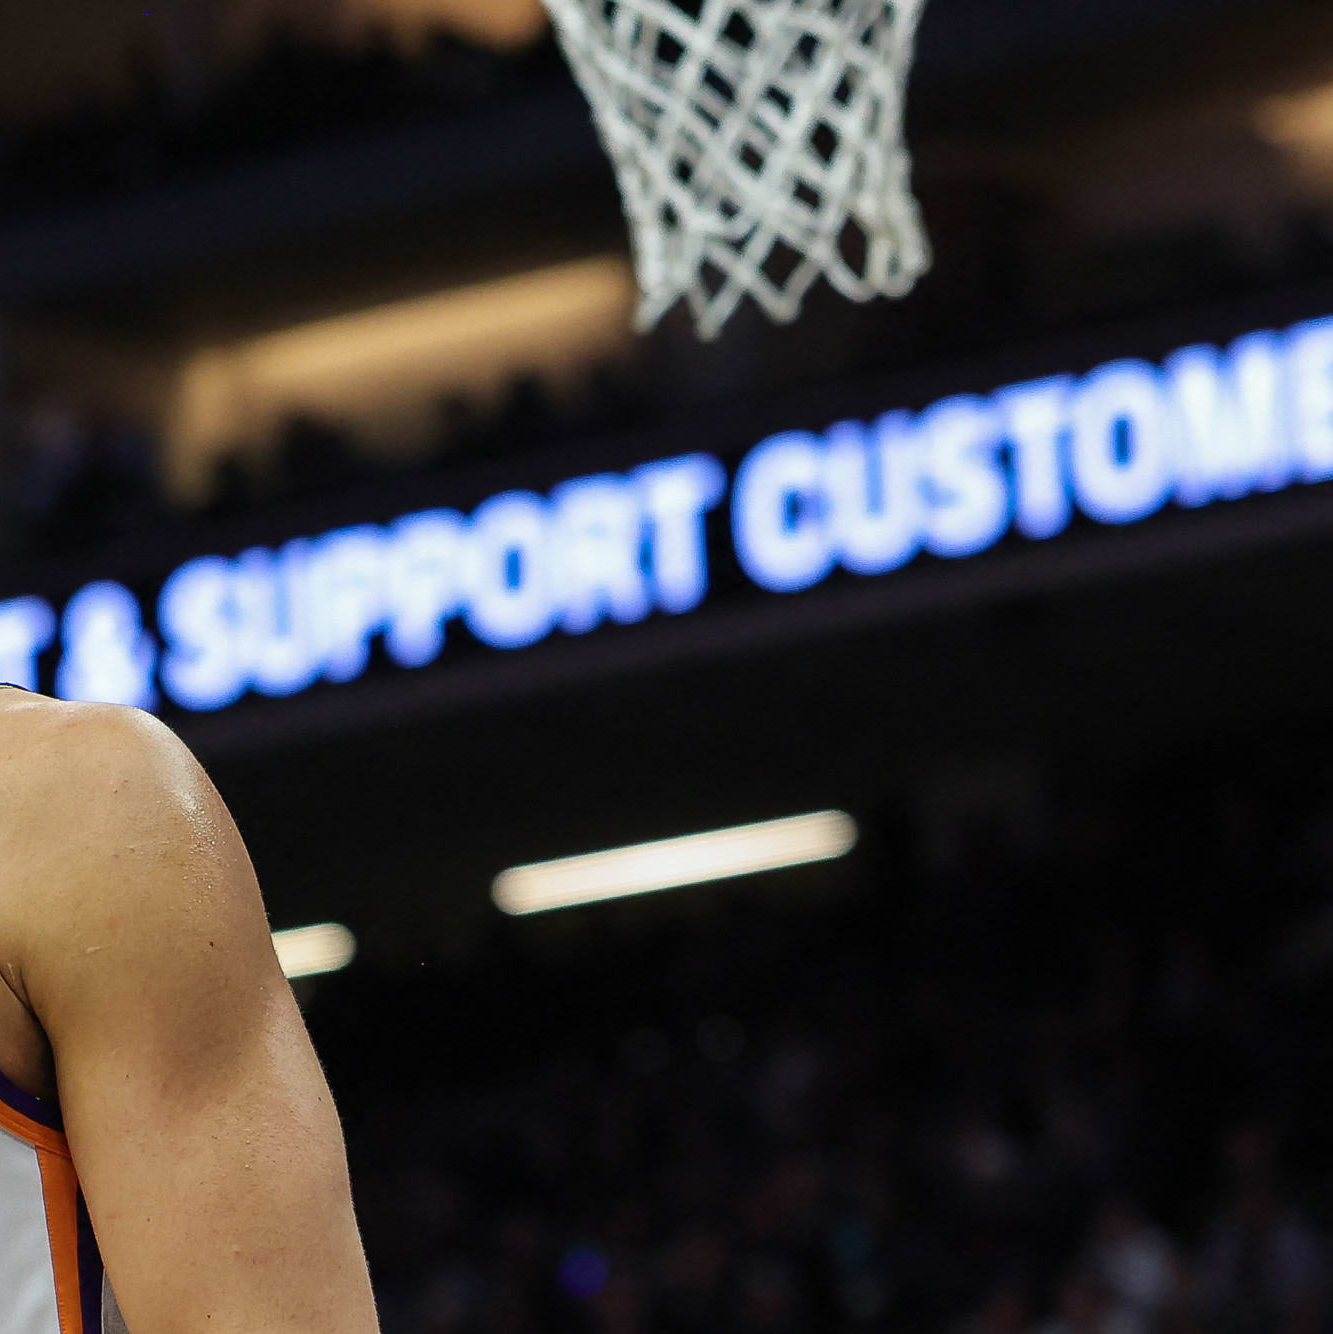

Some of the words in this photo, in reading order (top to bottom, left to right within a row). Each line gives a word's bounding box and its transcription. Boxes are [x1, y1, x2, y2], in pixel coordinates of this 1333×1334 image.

[54, 579, 159, 714] &
[156, 453, 729, 713] SUPPORT
[732, 313, 1333, 593] CUSTOME
